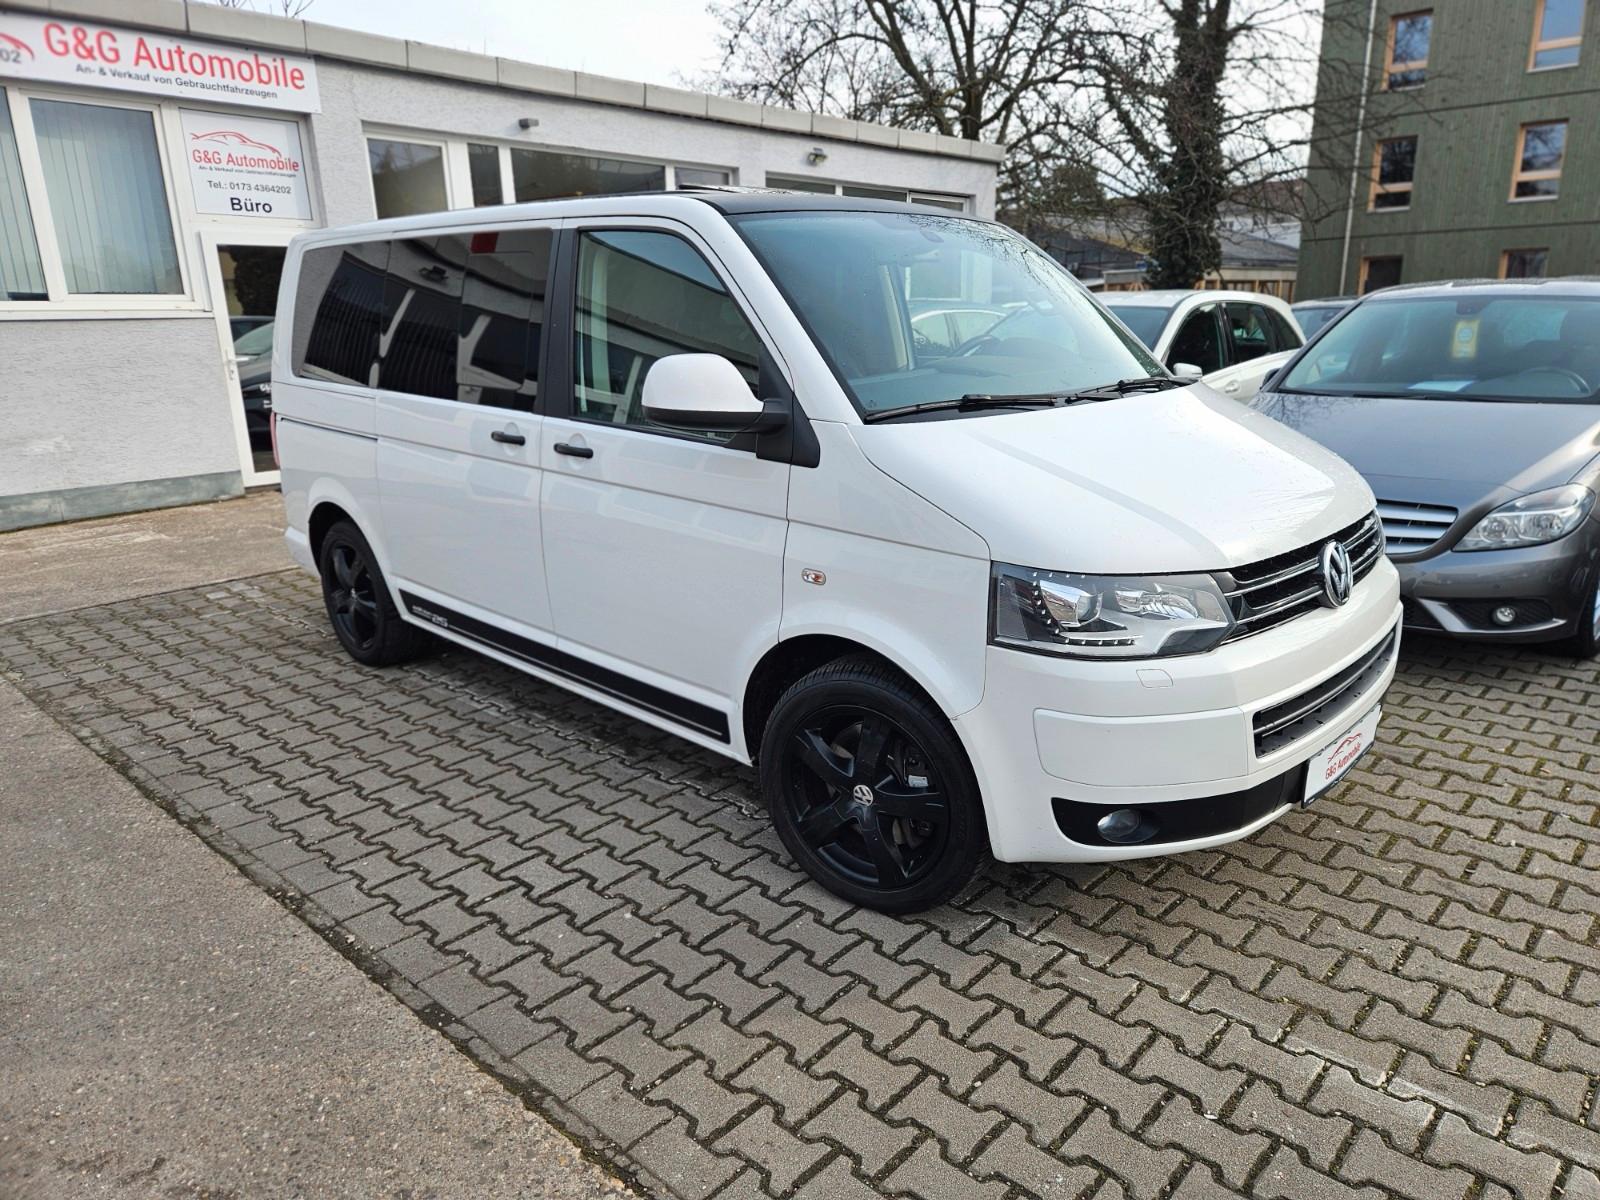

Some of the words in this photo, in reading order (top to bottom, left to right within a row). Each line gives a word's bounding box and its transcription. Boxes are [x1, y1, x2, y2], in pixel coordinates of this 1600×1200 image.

[43, 22, 120, 64] G&G
[134, 37, 305, 90] Automobile
[76, 63, 95, 74] An-
[98, 67, 107, 76] &
[109, 68, 151, 82] Verkauf
[153, 75, 172, 85] von
[175, 77, 278, 99] Gebrauchtfahrzeugen
[192, 149, 222, 165] G&G
[226, 153, 299, 172] Automobile
[207, 180, 228, 190] Tel.:
[229, 182, 252, 191] 0173
[254, 185, 292, 194] 4364202
[230, 197, 273, 213] Büro
